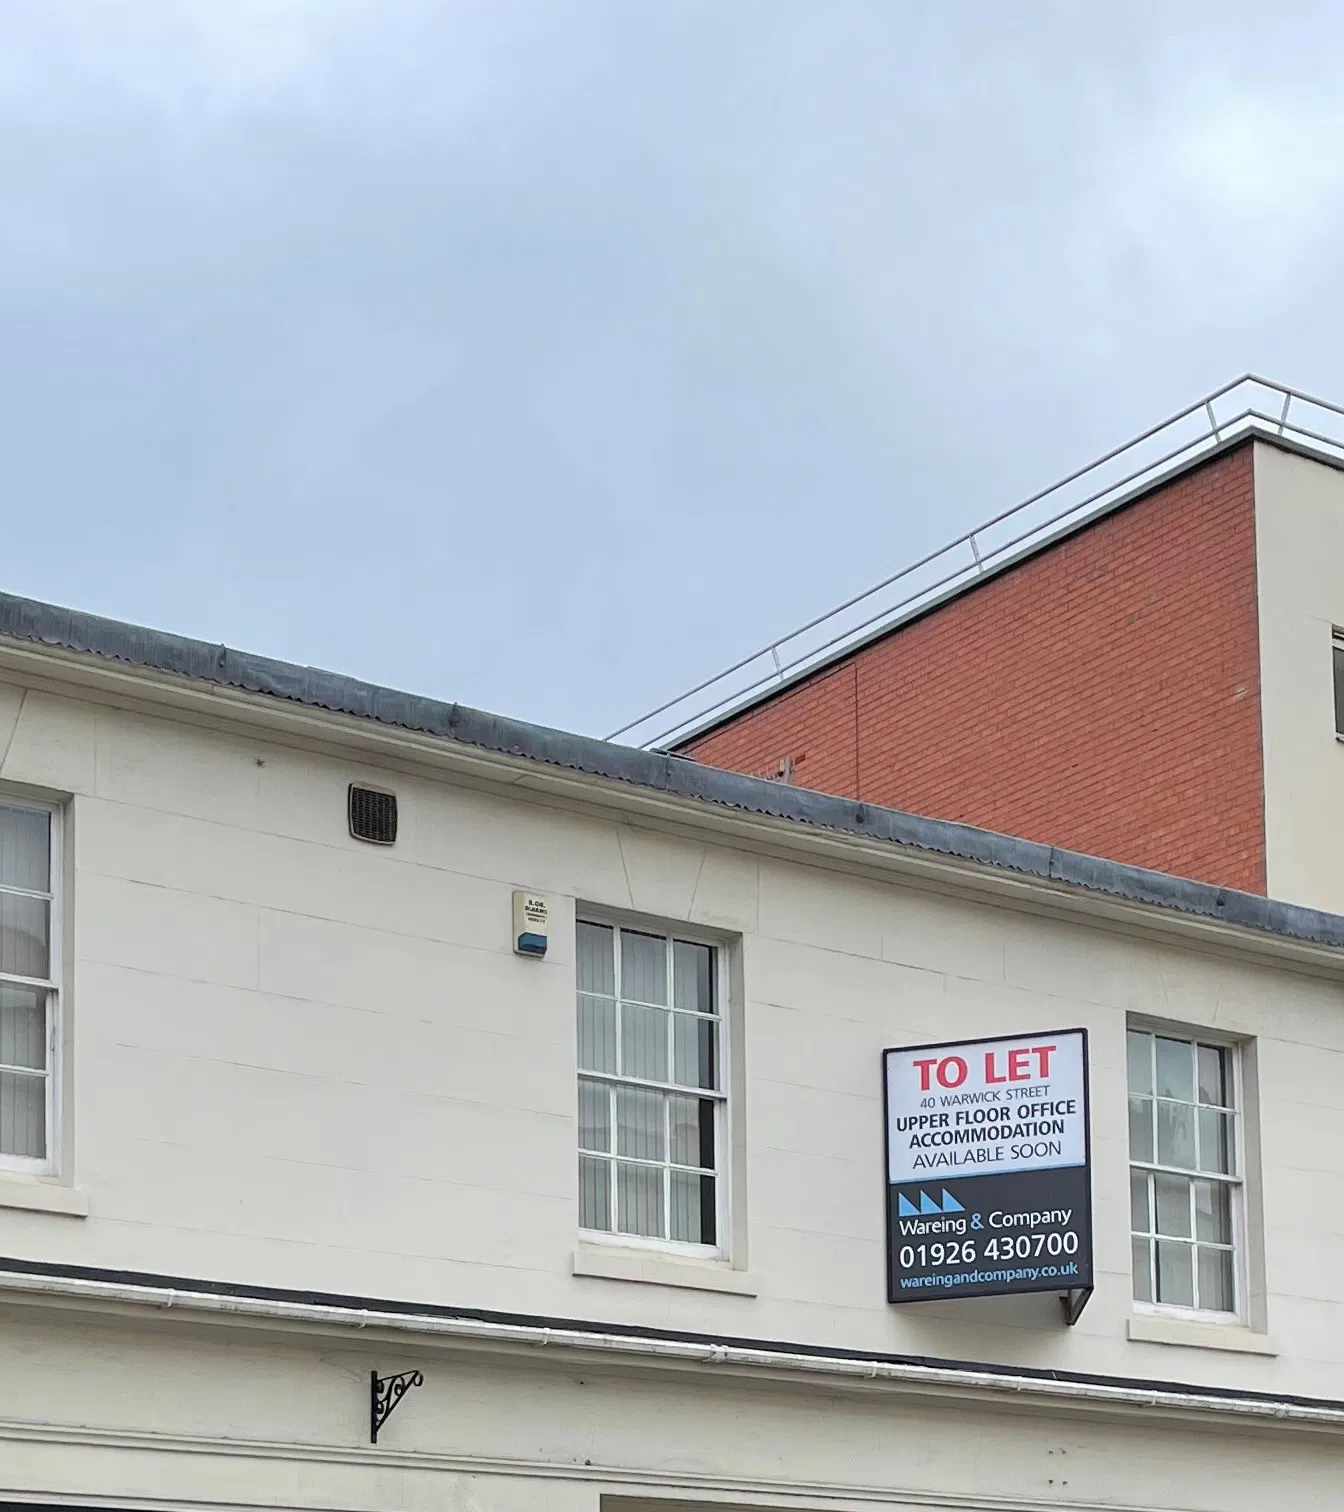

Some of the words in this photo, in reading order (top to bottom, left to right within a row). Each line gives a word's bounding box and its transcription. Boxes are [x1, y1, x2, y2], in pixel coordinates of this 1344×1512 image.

[913, 1055, 968, 1091] TO
[984, 1045, 1056, 1084] LET
[920, 1096, 936, 1109] 40
[939, 1090, 1002, 1108] WARWICK
[1006, 1085, 1051, 1100] STREET
[896, 1112, 949, 1132] UPPER
[956, 1107, 1011, 1126] FLOOR
[1017, 1099, 1076, 1119] OFFICE
[909, 1119, 1065, 1150] ACCOMMODATION
[912, 1146, 1005, 1170] AVAILABLE
[1010, 1140, 1062, 1160] SOON
[898, 1217, 967, 1236] Wareing
[970, 1213, 984, 1230] &
[988, 1208, 1072, 1230] Company
[899, 1240, 977, 1268] 01926
[984, 1231, 1079, 1261] 430700
[900, 1262, 1079, 1288] wareingandcompany.co.uk
